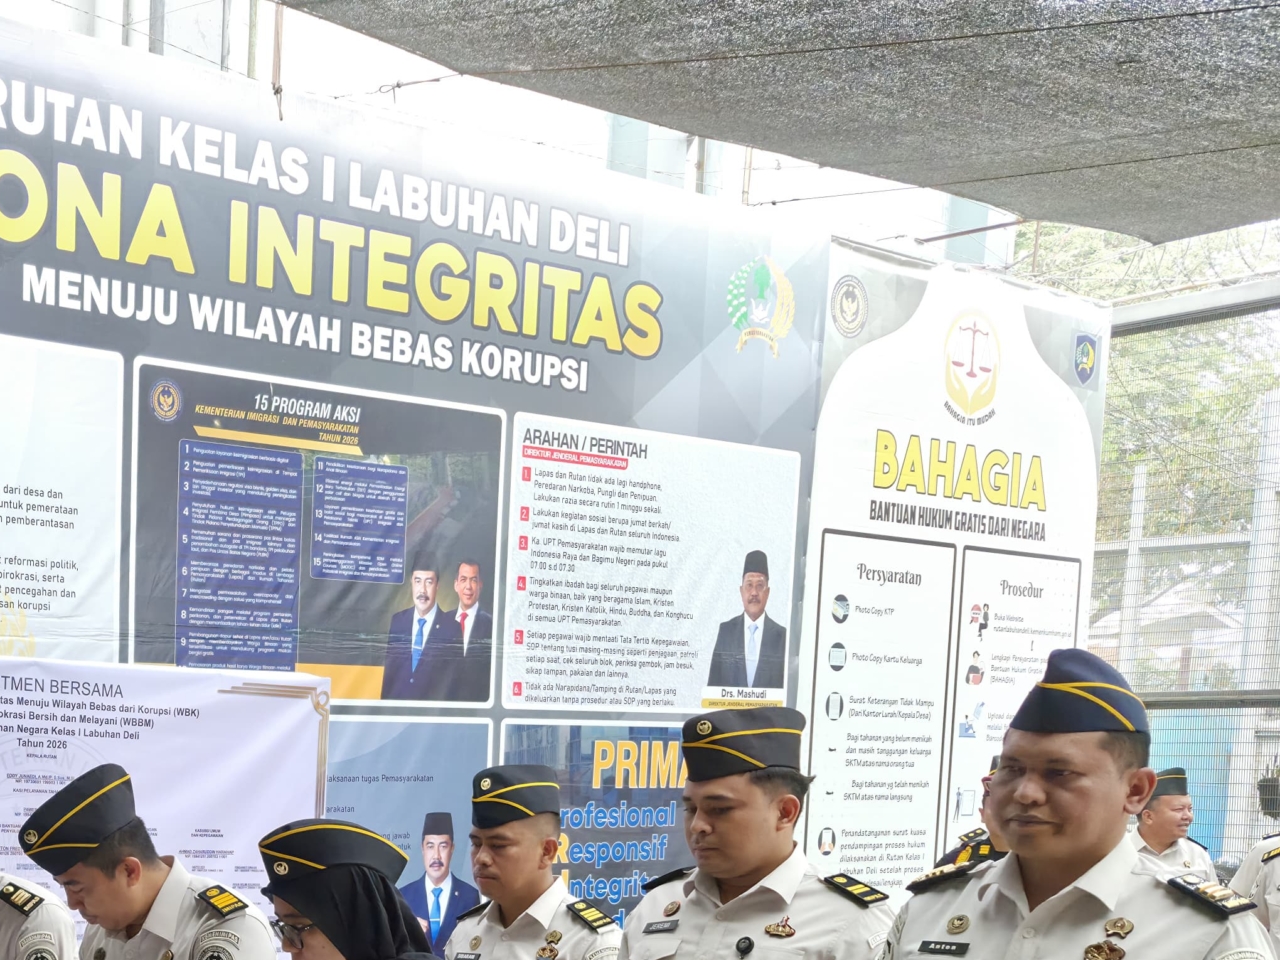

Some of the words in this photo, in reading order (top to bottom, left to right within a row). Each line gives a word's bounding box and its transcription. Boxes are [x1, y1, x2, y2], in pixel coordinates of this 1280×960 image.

[160, 116, 309, 195] KELAS
[322, 155, 336, 203] I
[348, 162, 538, 248] LABUHAN
[549, 204, 630, 267] DELI
[229, 199, 664, 357] INTEGRITAS
[23, 265, 177, 324] MENUJU
[189, 295, 341, 351] WILAYAH
[351, 323, 452, 368] BEBAS
[462, 342, 587, 390] KORUPSI
[195, 405, 246, 419] KEMENTERIAN
[247, 412, 280, 423] IMIGRASI
[283, 416, 297, 426] DAN
[298, 419, 359, 434] PEMASYARAKATAN
[255, 394, 268, 411] 15
[271, 396, 331, 418] PROGRAM
[333, 405, 361, 422] AKSI
[318, 432, 341, 443] TAHUN
[342, 434, 359, 445] 2026
[523, 428, 578, 449] ARAHAN
[582, 436, 587, 451] /
[590, 437, 647, 458] PERINTAH
[873, 431, 1046, 510] BAHAGIA
[3, 484, 20, 495] dari
[24, 486, 44, 497] desa
[47, 489, 63, 499] dan
[870, 502, 916, 524] BANTUAN
[918, 507, 952, 529] HUKUM
[955, 512, 986, 534] GRATIS
[988, 516, 1009, 536] DARI
[1011, 520, 1045, 541] NEGARA
[857, 563, 921, 586] Persyaratan
[1000, 580, 1044, 598] Prosedur
[855, 606, 871, 614] Photo
[872, 607, 884, 616] Copy
[884, 608, 894, 616] KTP
[50, 680, 123, 698] BERSAMA
[722, 688, 734, 700] Drs.
[737, 689, 766, 699] Mashudi
[17, 696, 49, 709] Menuju
[52, 699, 86, 711] Wilayah
[89, 701, 116, 712] Bebas
[119, 704, 135, 713] dari
[138, 705, 171, 716] Korupsi
[173, 708, 199, 719] (WBK)
[17, 724, 48, 736] Negara
[51, 726, 75, 736] Kelas
[78, 728, 80, 736] I
[84, 729, 120, 738] Labuhan
[124, 730, 139, 740] Deli
[17, 738, 44, 748] Tahun
[47, 740, 67, 749] 2026
[560, 801, 676, 829] rofesional
